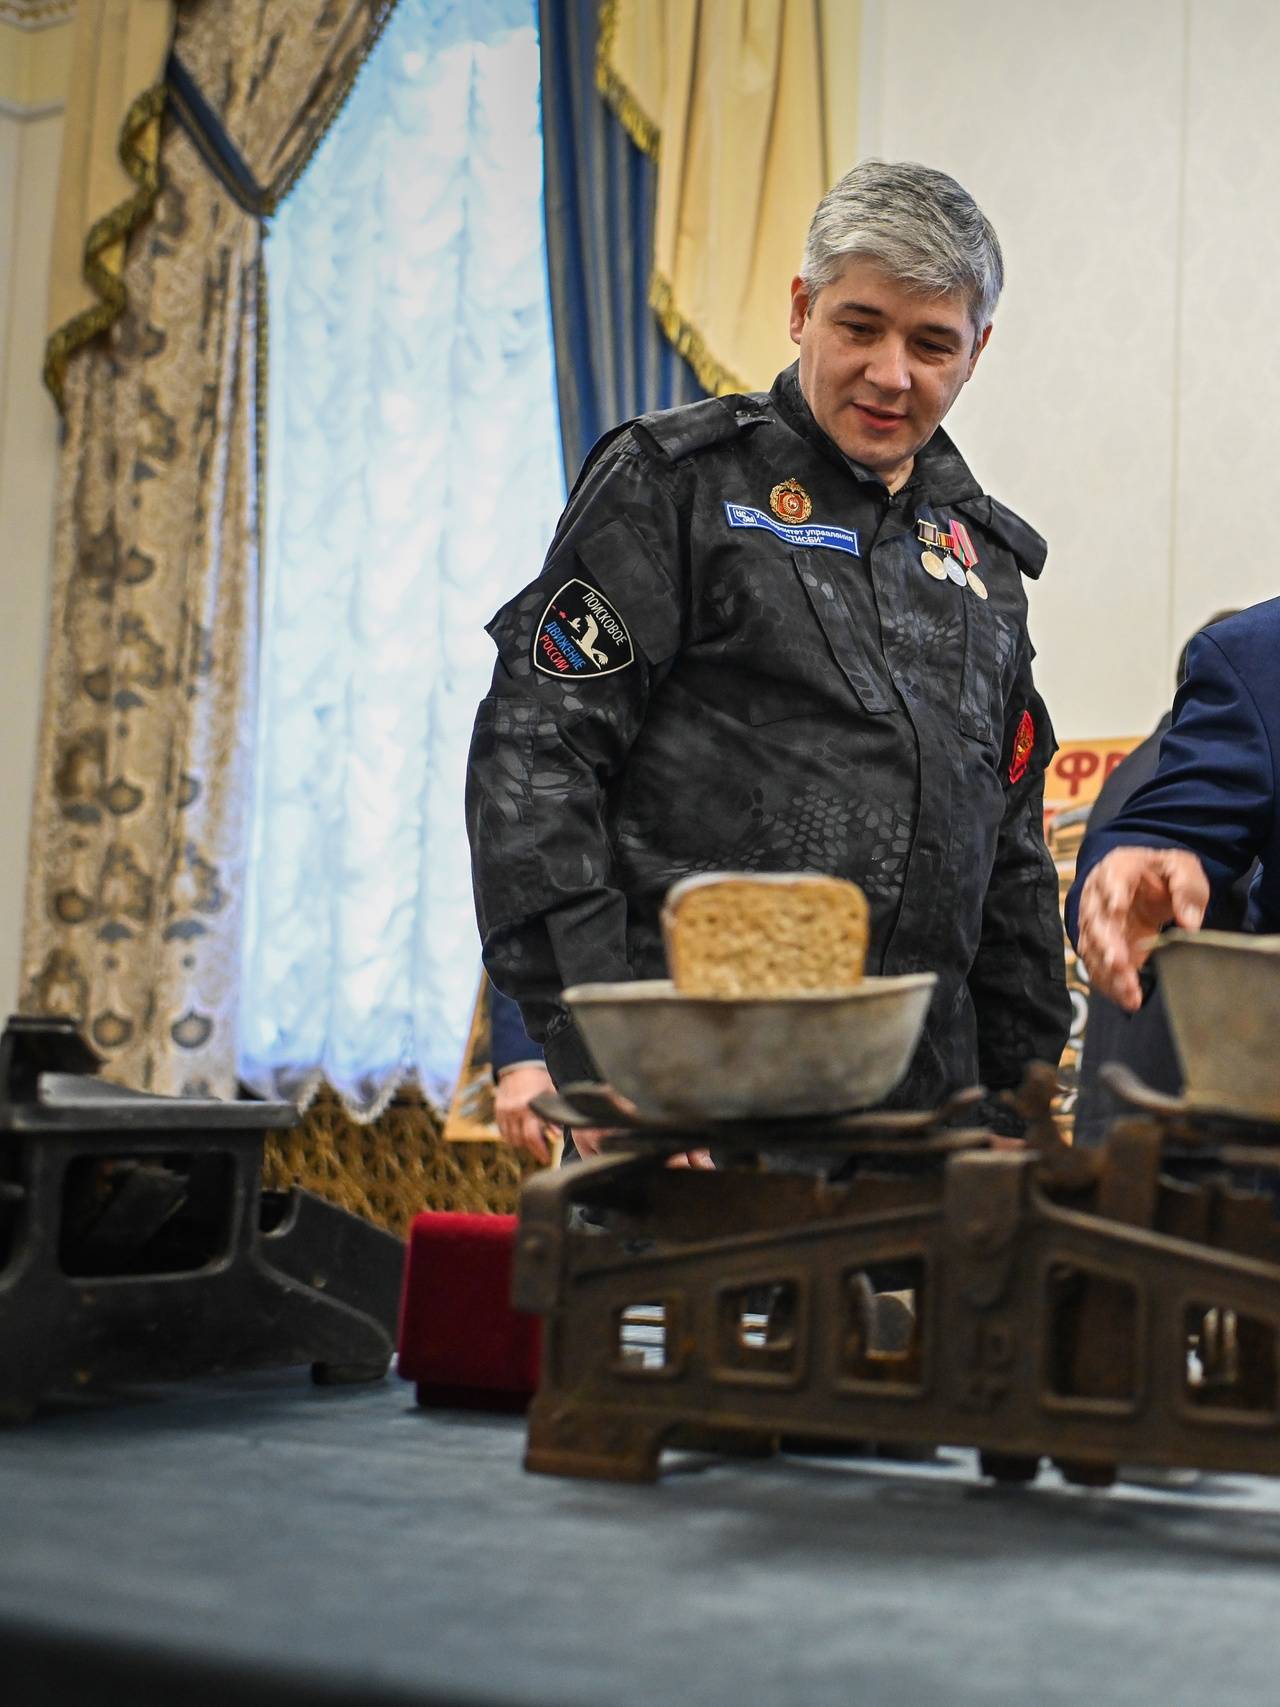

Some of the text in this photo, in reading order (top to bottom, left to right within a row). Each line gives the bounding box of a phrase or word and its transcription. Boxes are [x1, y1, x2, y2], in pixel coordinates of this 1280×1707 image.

[582, 591, 627, 646] ПОИСКОВОЕ
[540, 634, 570, 672] РОССИИ
[544, 621, 587, 671] ДВИЖЕНИЕ
